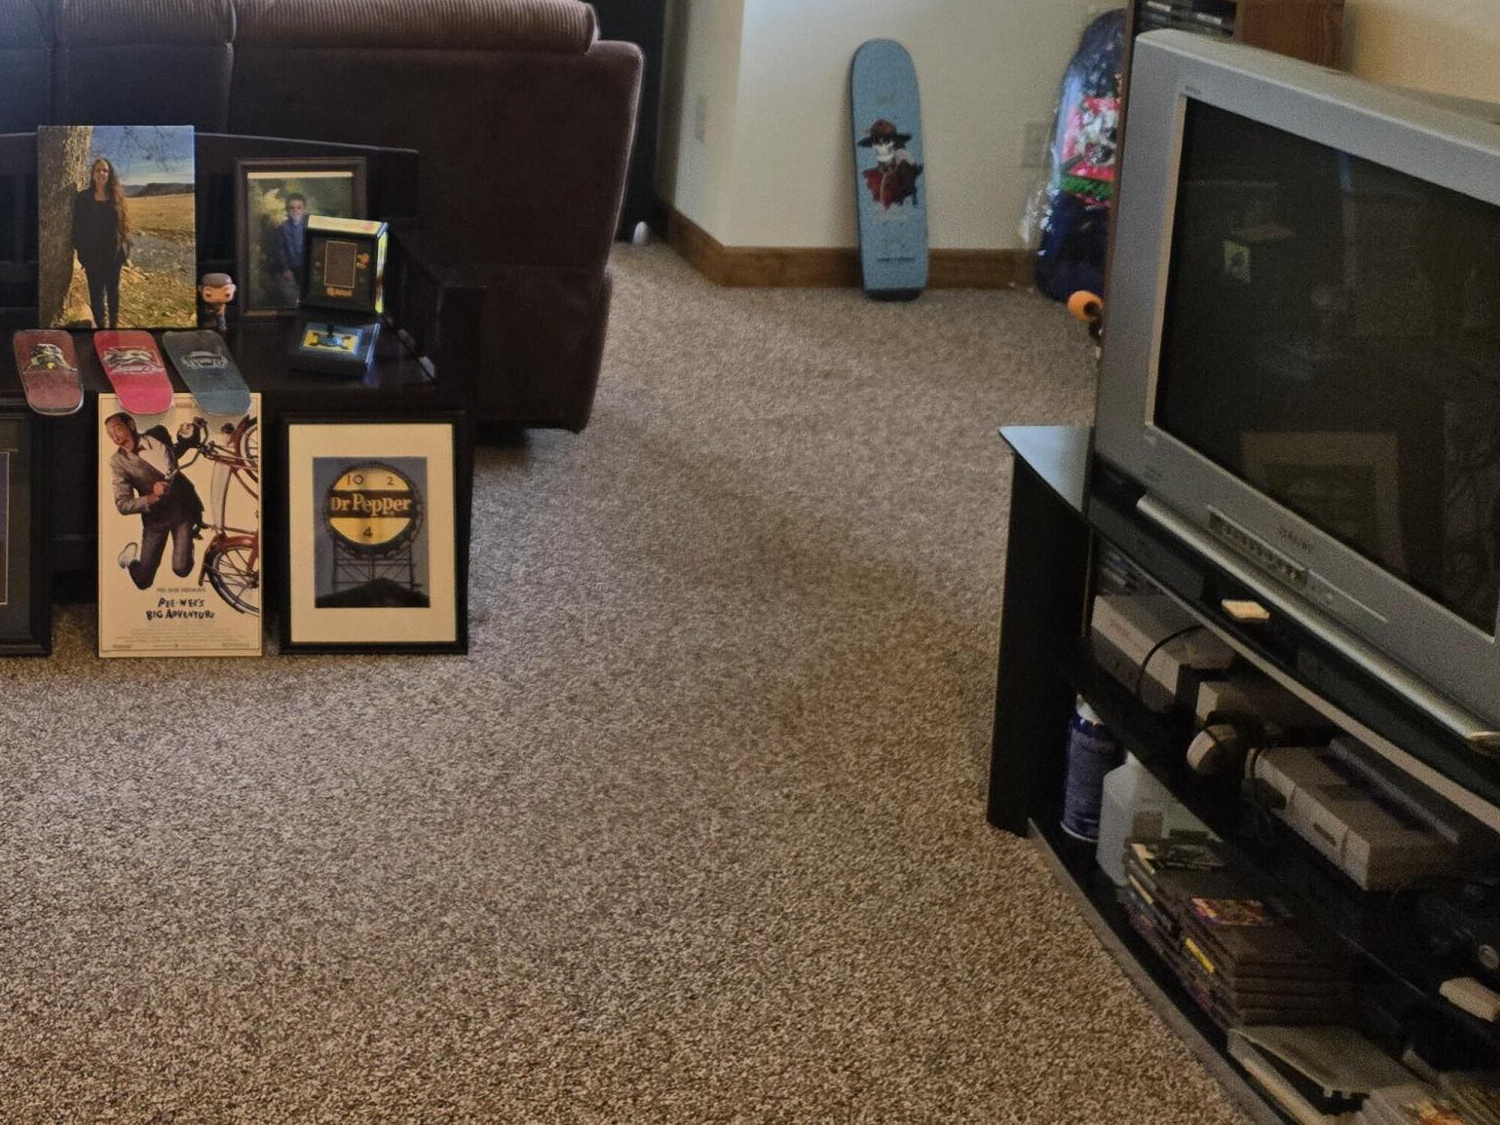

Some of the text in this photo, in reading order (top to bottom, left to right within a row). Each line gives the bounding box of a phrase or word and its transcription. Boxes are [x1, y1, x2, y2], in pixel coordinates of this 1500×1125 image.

[347, 475, 394, 486] 10 2
[331, 493, 412, 517] Dr Pepper
[363, 526, 373, 537] 4
[146, 610, 163, 620] BIG
